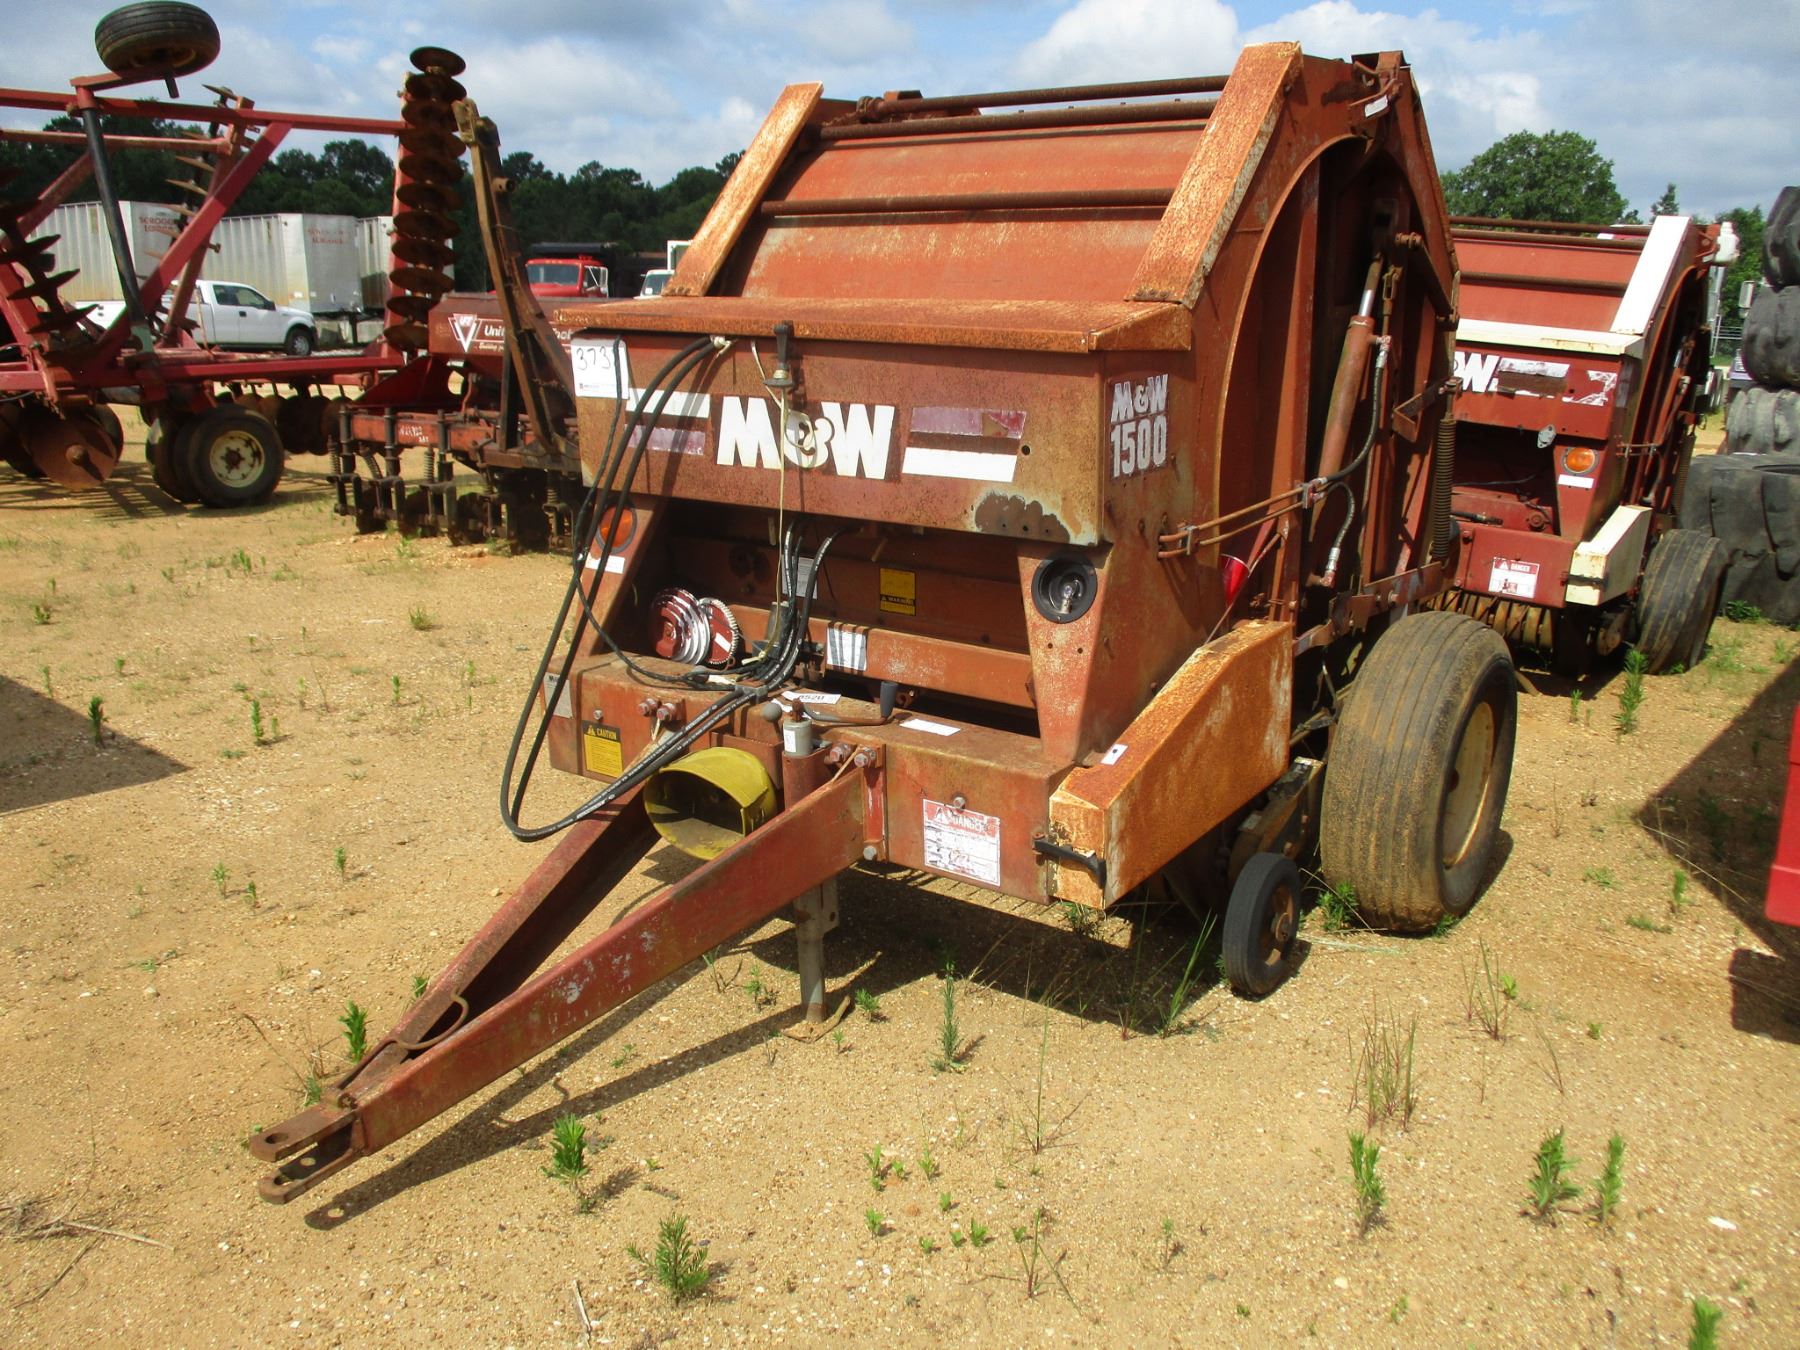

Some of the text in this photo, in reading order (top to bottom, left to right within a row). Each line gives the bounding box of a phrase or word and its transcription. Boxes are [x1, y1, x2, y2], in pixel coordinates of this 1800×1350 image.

[484, 325, 505, 336] Unit
[1110, 373, 1168, 423] M&W
[717, 396, 895, 480] M&W
[1110, 415, 1167, 478] 1500
[596, 728, 617, 740] CAUTION
